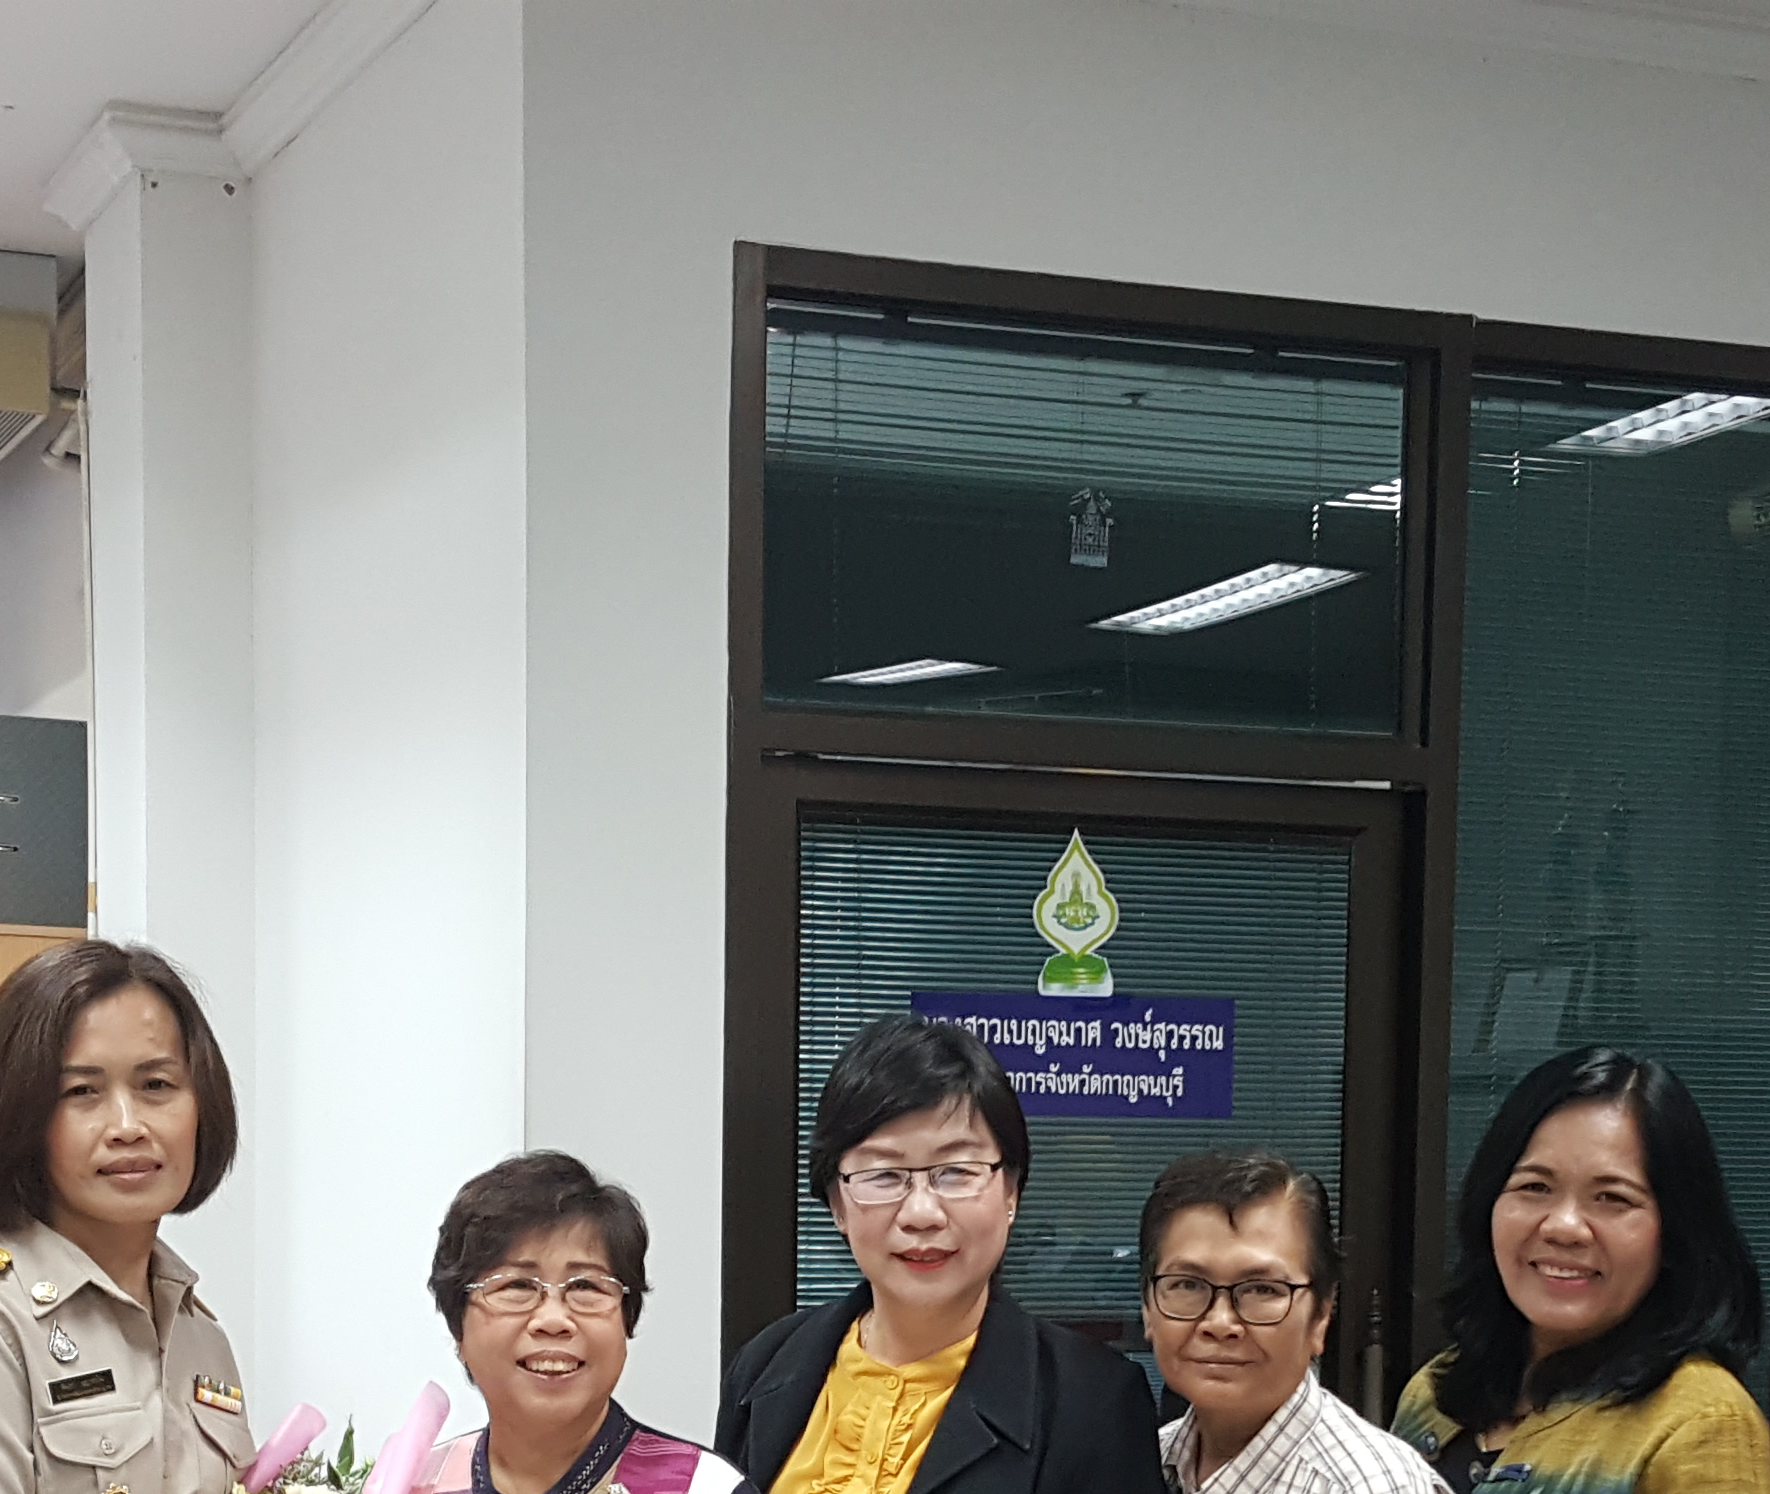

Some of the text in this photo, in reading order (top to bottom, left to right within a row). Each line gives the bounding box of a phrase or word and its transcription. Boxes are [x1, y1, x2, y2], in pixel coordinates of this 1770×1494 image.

[1110, 1007, 1224, 1062] วงษ์สุวรรณ
[1005, 1062, 1184, 1107] าการจังหวัดกาญจนบุรี
